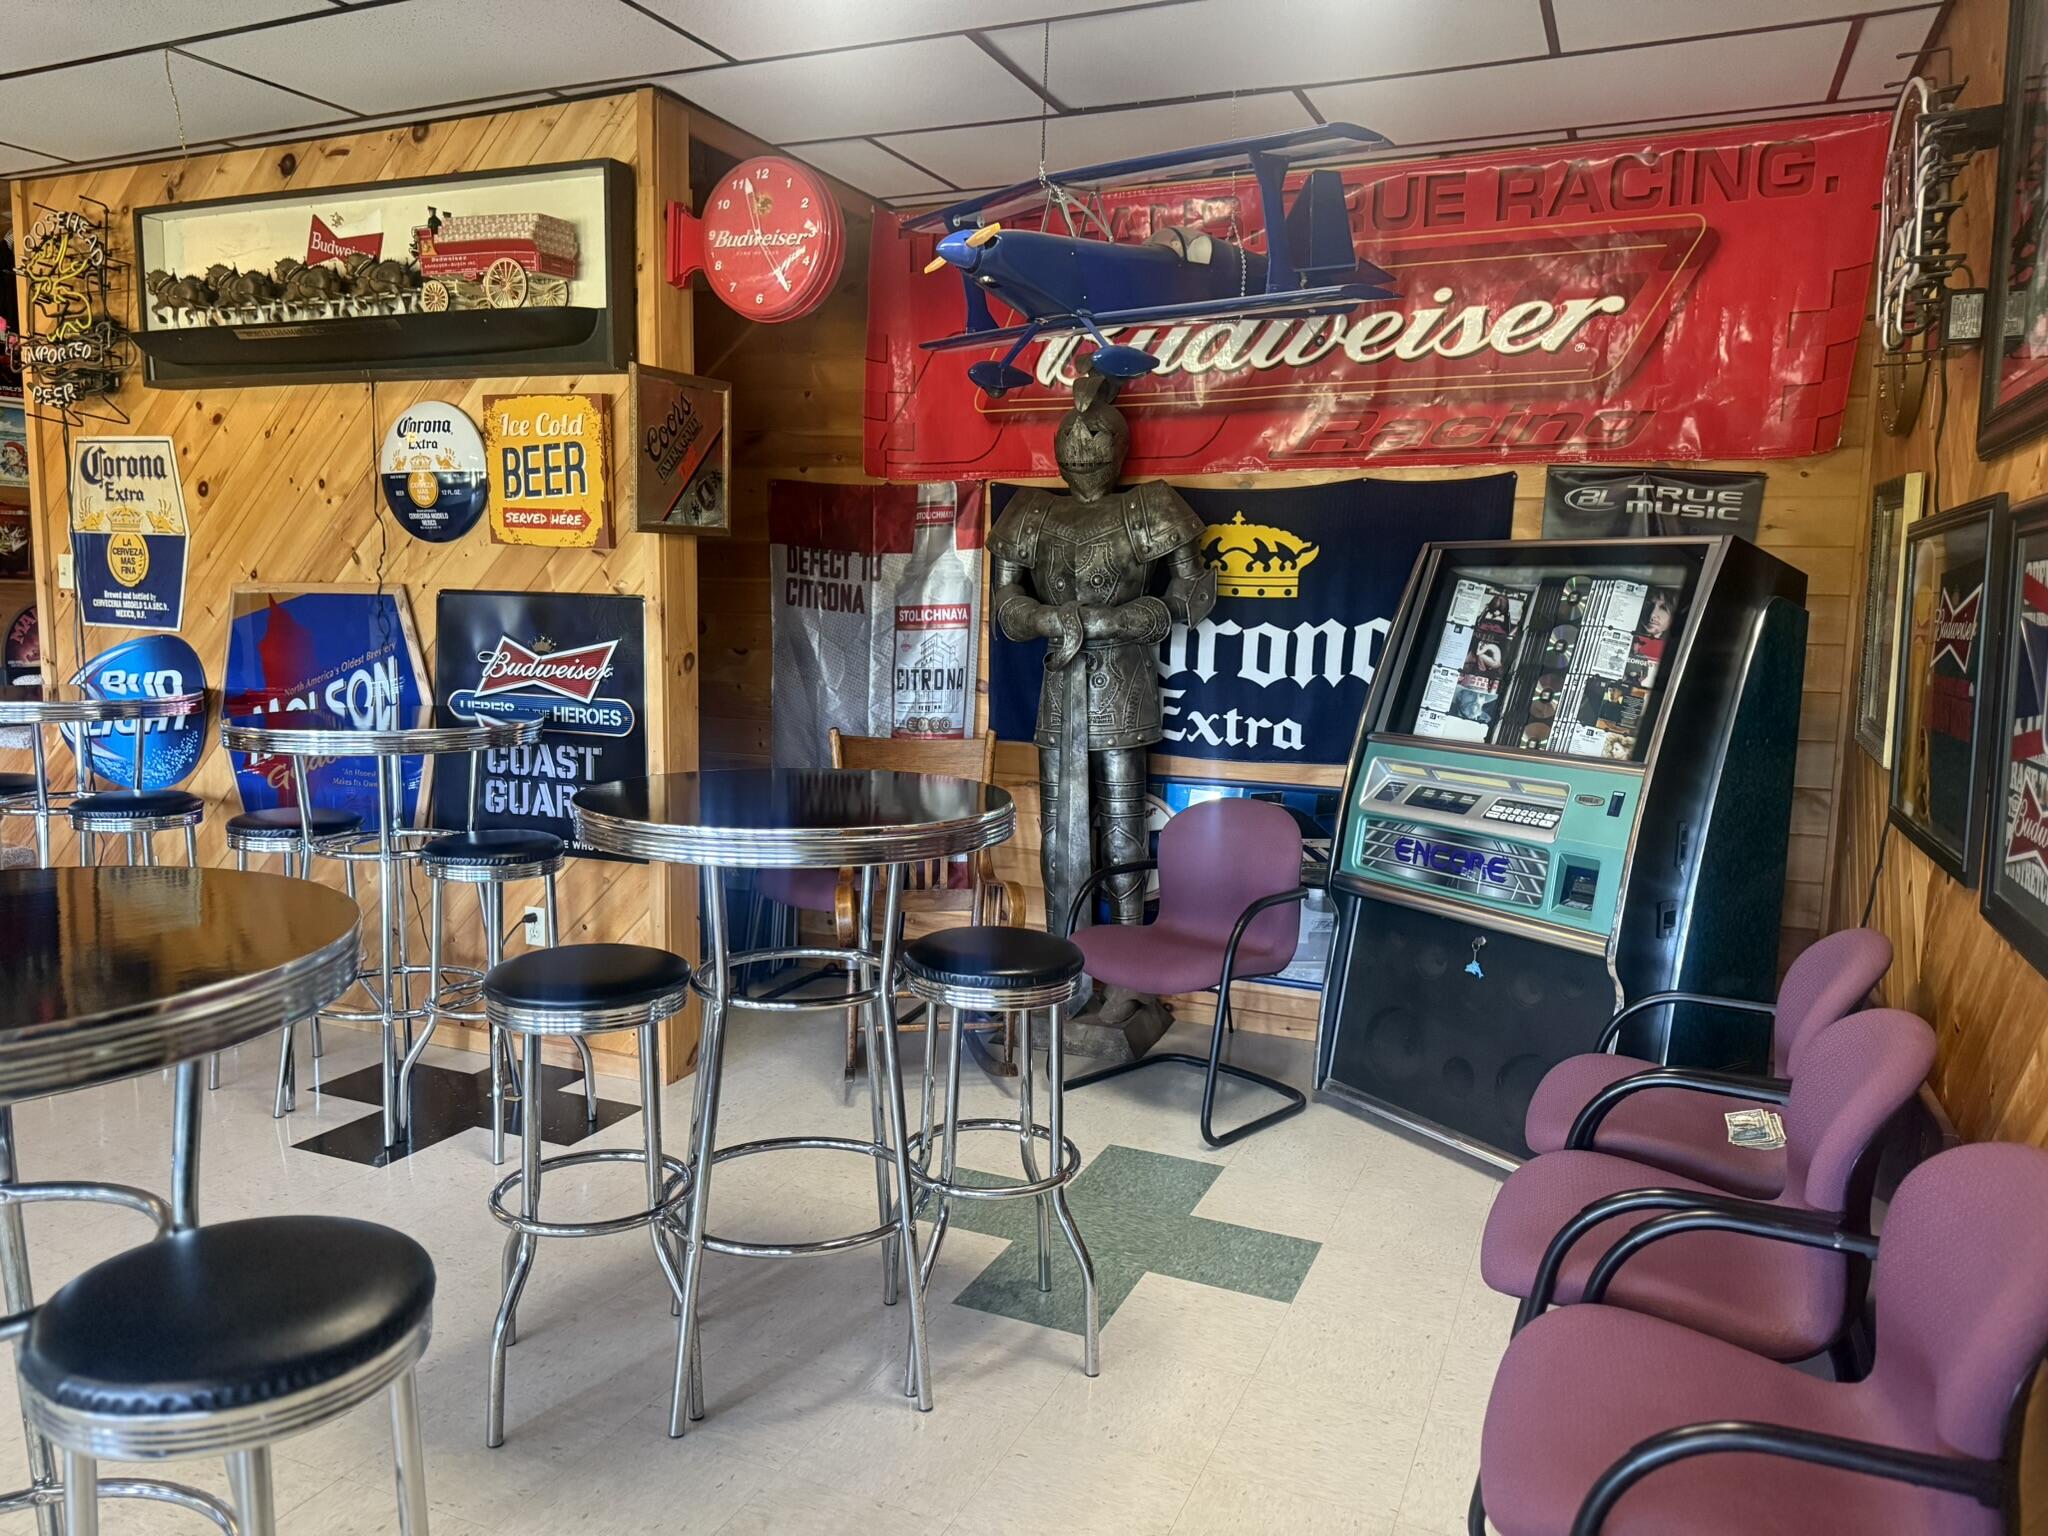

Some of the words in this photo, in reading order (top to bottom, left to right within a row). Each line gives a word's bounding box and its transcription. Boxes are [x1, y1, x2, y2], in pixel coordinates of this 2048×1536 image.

[755, 168, 769, 179] 12
[786, 177, 792, 188] 1
[732, 179, 745, 190] 11
[1343, 171, 1468, 233] RUE
[1497, 140, 1841, 223] RACING.
[717, 199, 731, 210] 10
[800, 197, 809, 209] 2
[13, 211, 104, 276] MOOSEHEAD
[708, 230, 716, 241] 9
[714, 228, 808, 248] Budweiser
[714, 261, 722, 271] 8
[802, 255, 810, 266] 4
[729, 281, 737, 293] 7
[755, 293, 764, 304] 6
[24, 342, 93, 363] IMPORTED
[32, 382, 77, 408] BEER
[397, 416, 453, 439] Corona
[501, 412, 529, 438] Ice
[535, 411, 585, 438] Cold
[644, 390, 692, 463] Coors
[1295, 403, 1656, 450] Racing
[80, 444, 168, 489] Corona
[501, 440, 588, 501] BEER
[104, 481, 145, 502] Extra
[1627, 484, 1744, 505] TRUE
[505, 511, 547, 525] SERVED
[550, 512, 583, 526] HERE
[1626, 500, 1741, 521] MUSIC
[112, 546, 144, 557] CERVEZA
[122, 537, 132, 547] LA
[120, 556, 136, 566] MAS
[120, 565, 136, 575] FINA
[786, 545, 854, 580] DEFECT
[860, 552, 883, 583] TO
[785, 576, 866, 615] CITRONA
[898, 606, 968, 623] STOLICHNAYA
[1935, 607, 1978, 642] Budweiser
[284, 680, 306, 697] North
[306, 666, 340, 689] America's
[340, 655, 365, 672] Oldest
[477, 650, 614, 681] Budweiser
[896, 667, 964, 691] CITRONA
[552, 705, 622, 727] HEROES
[1162, 688, 1305, 752] Extra
[486, 743, 603, 781] COAST
[485, 778, 588, 818] GUAR
[1394, 836, 1510, 884] ENCORE
